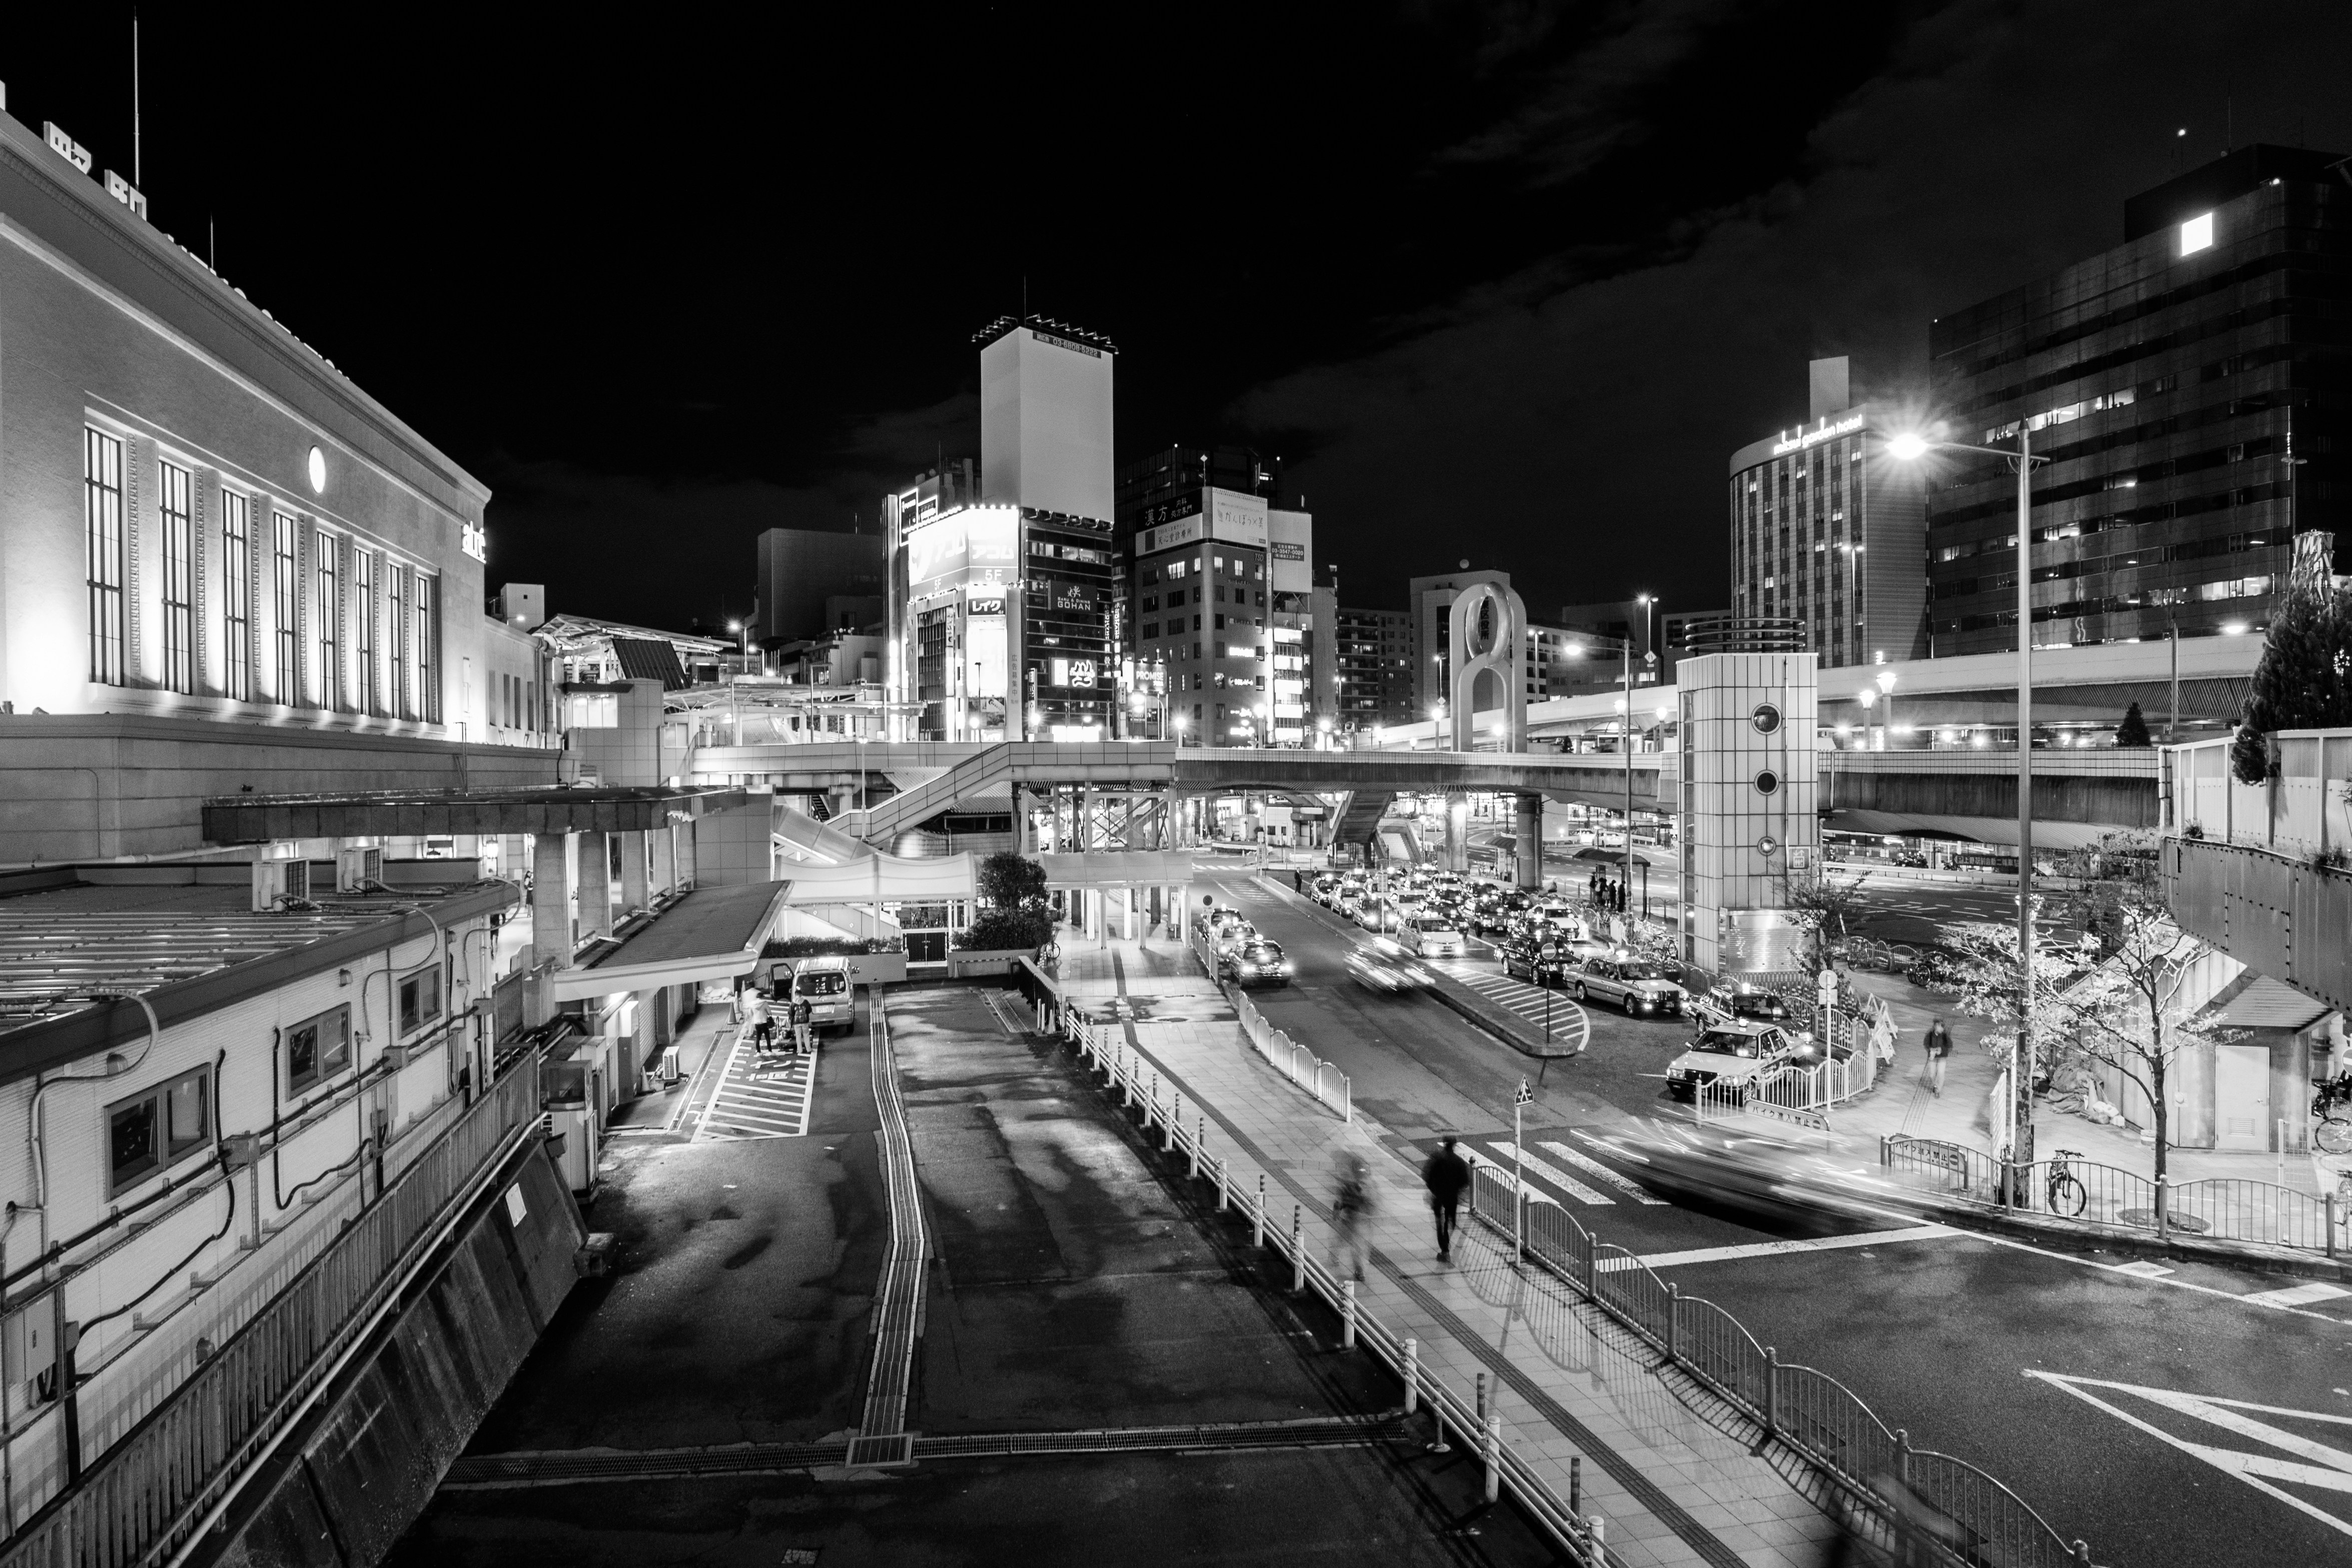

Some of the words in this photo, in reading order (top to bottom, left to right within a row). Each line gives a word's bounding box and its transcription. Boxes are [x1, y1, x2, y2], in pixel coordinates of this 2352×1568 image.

[1145, 504, 1168, 526] 漢方
[972, 544, 1015, 560] アコム
[1254, 553, 1264, 561] TSD
[985, 569, 1002, 581] 5F
[934, 578, 942, 590] 5F
[972, 600, 1001, 612] レイク
[1057, 601, 1091, 611] GOHAN
[1480, 595, 1490, 640] 東区役所
[1136, 670, 1164, 681] PROMISE
[1753, 1106, 1810, 1127] バイク進入禁止
